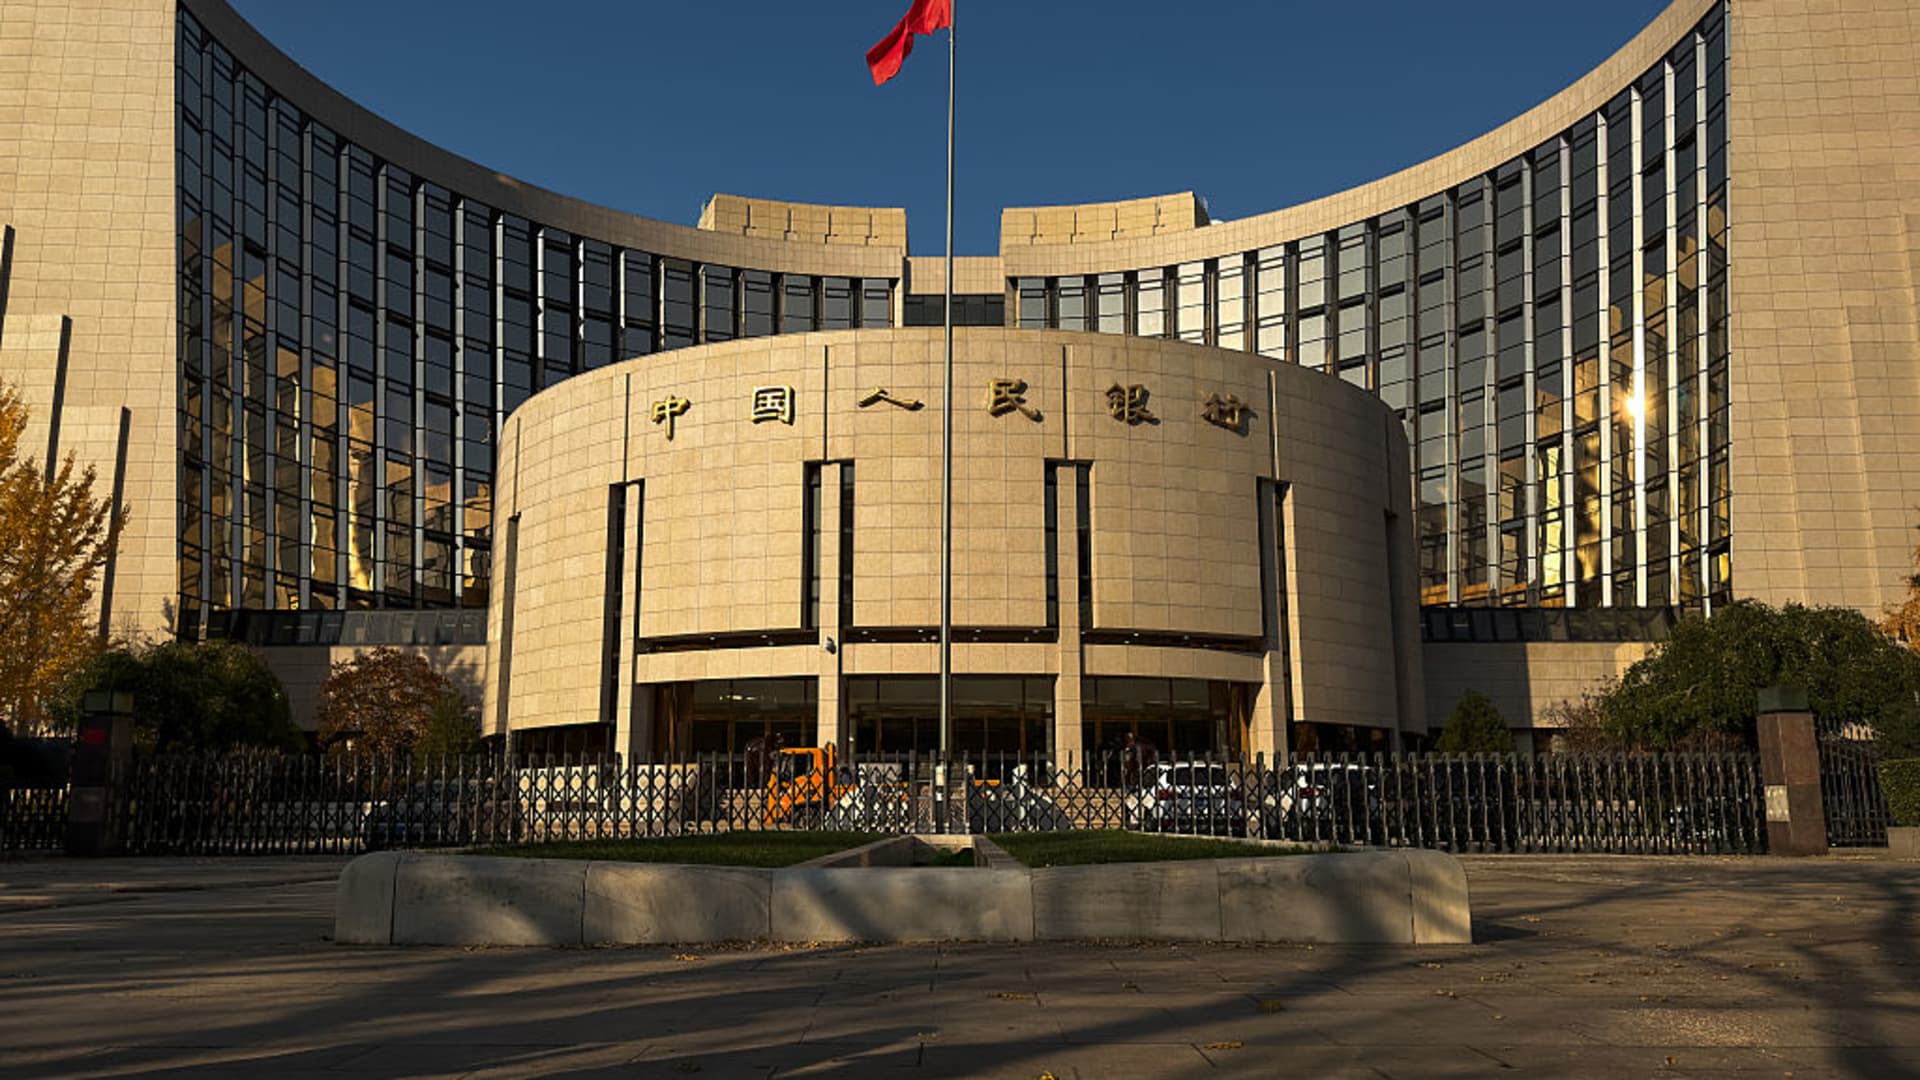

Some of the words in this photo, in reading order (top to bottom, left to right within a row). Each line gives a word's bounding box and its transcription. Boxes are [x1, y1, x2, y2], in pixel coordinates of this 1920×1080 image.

[652, 378, 1254, 440] 中国人民银行
